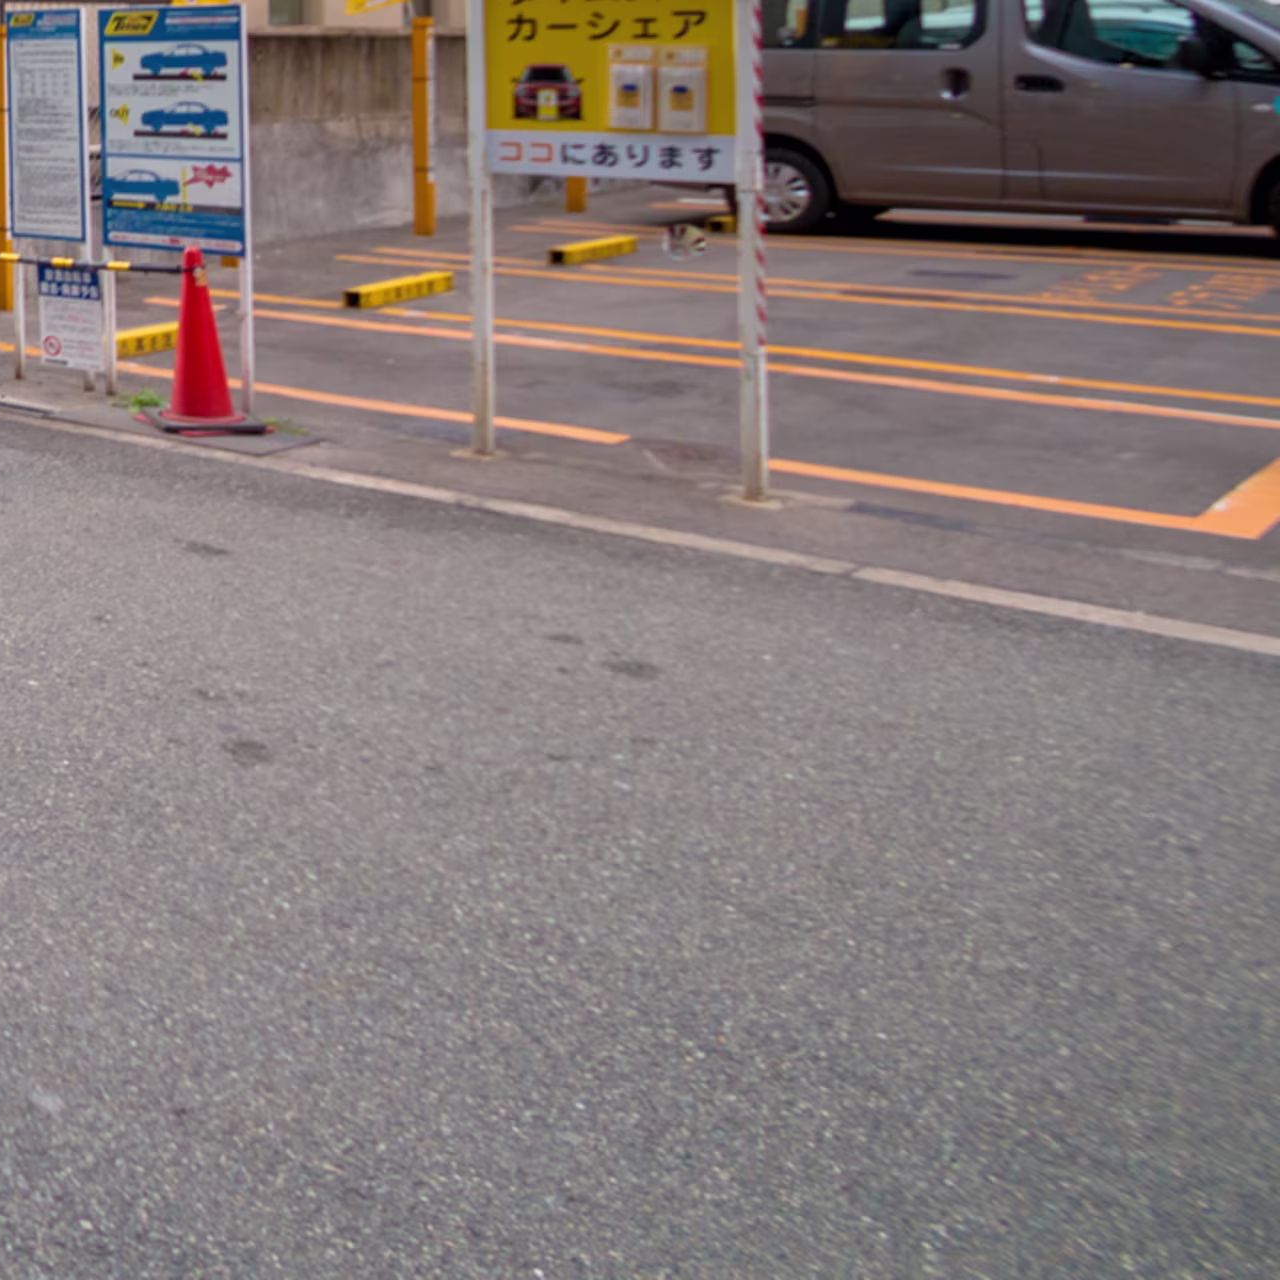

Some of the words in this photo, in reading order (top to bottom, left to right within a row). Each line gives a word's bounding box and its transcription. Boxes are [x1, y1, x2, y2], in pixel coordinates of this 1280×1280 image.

[506, 10, 707, 43] カーシェア
[498, 140, 721, 171] ココにあります
